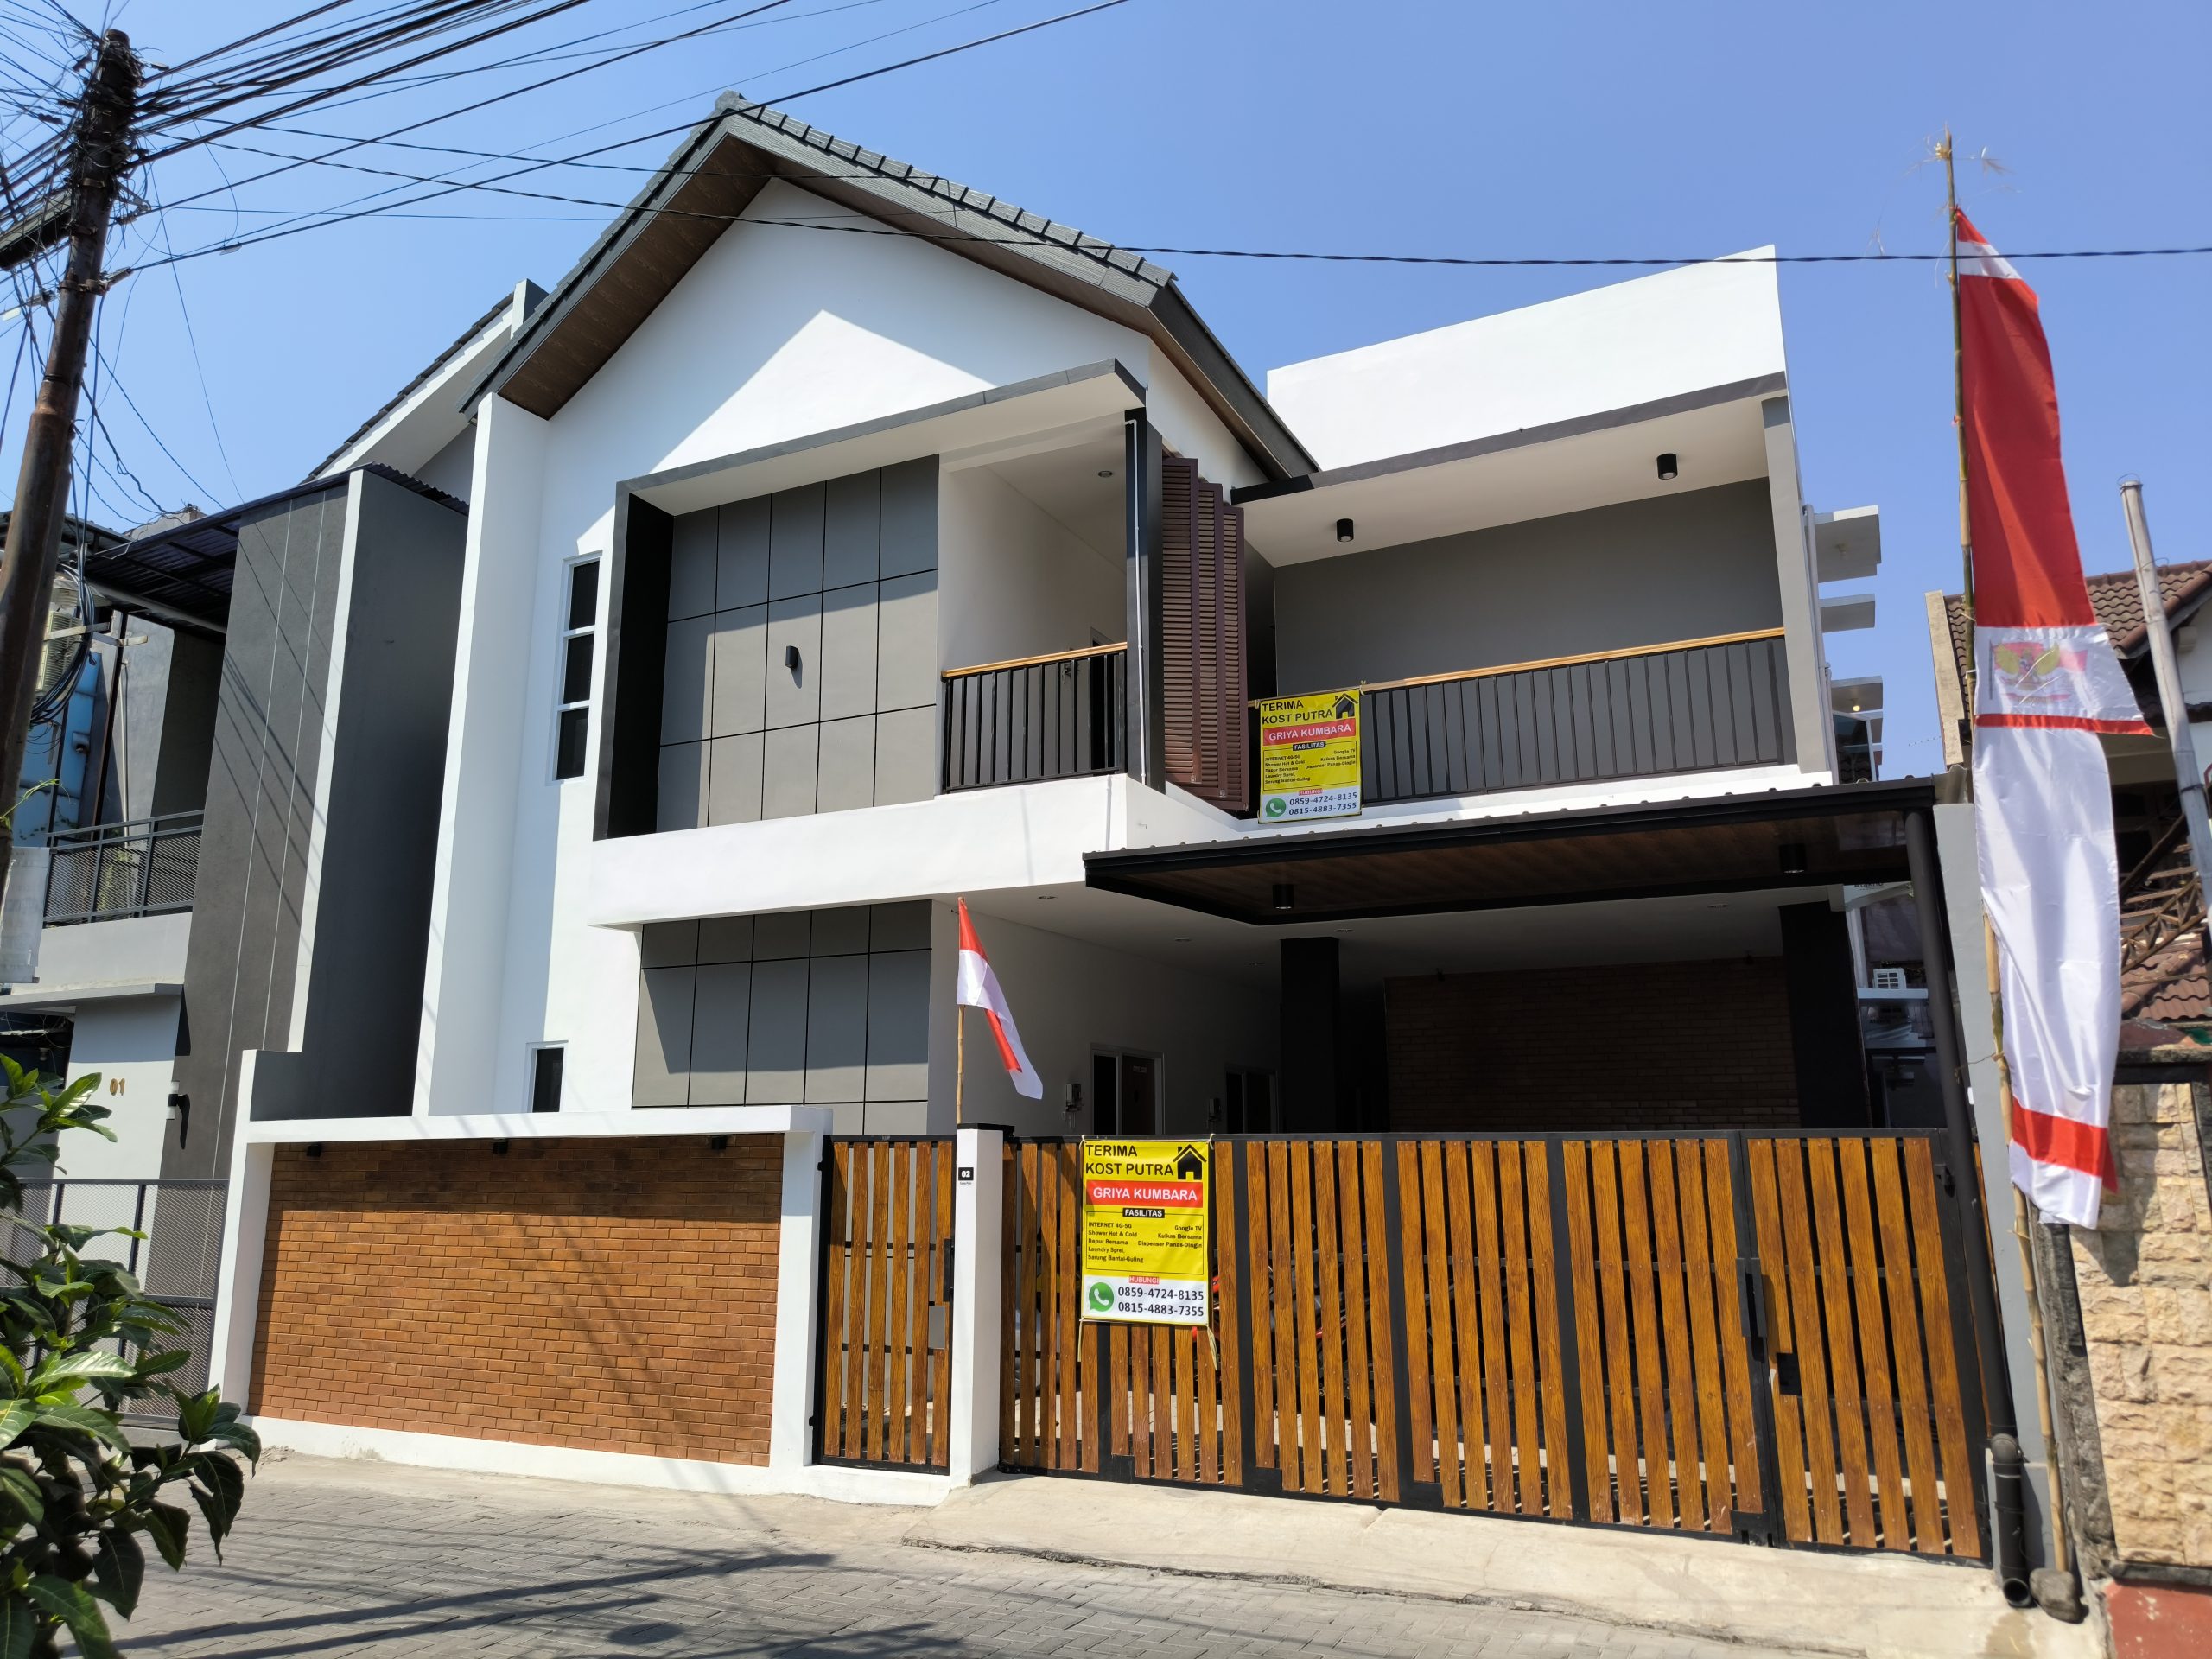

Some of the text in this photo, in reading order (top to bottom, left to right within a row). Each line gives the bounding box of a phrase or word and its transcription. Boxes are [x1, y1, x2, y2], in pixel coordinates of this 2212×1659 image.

[1262, 700, 1304, 712] TERIMA
[1262, 709, 1333, 725] KOST PUTRA
[1269, 724, 1351, 741] GRIYA KUMBARA
[1294, 741, 1325, 750] FASILITAS
[1289, 791, 1357, 805] 0859-4724-8135
[1288, 802, 1357, 816] 0815-4883-7355
[110, 1078, 125, 1096] 01
[1085, 1144, 1138, 1157] TERIMA
[1085, 1162, 1174, 1176] KOST PUTRA
[1093, 1186, 1198, 1201] GRIYA KUMBARA
[1124, 1209, 1163, 1217] FASILITAS
[1118, 1287, 1204, 1300] 0859-4724-8135
[1118, 1301, 1204, 1316] 0815-4883-7355
